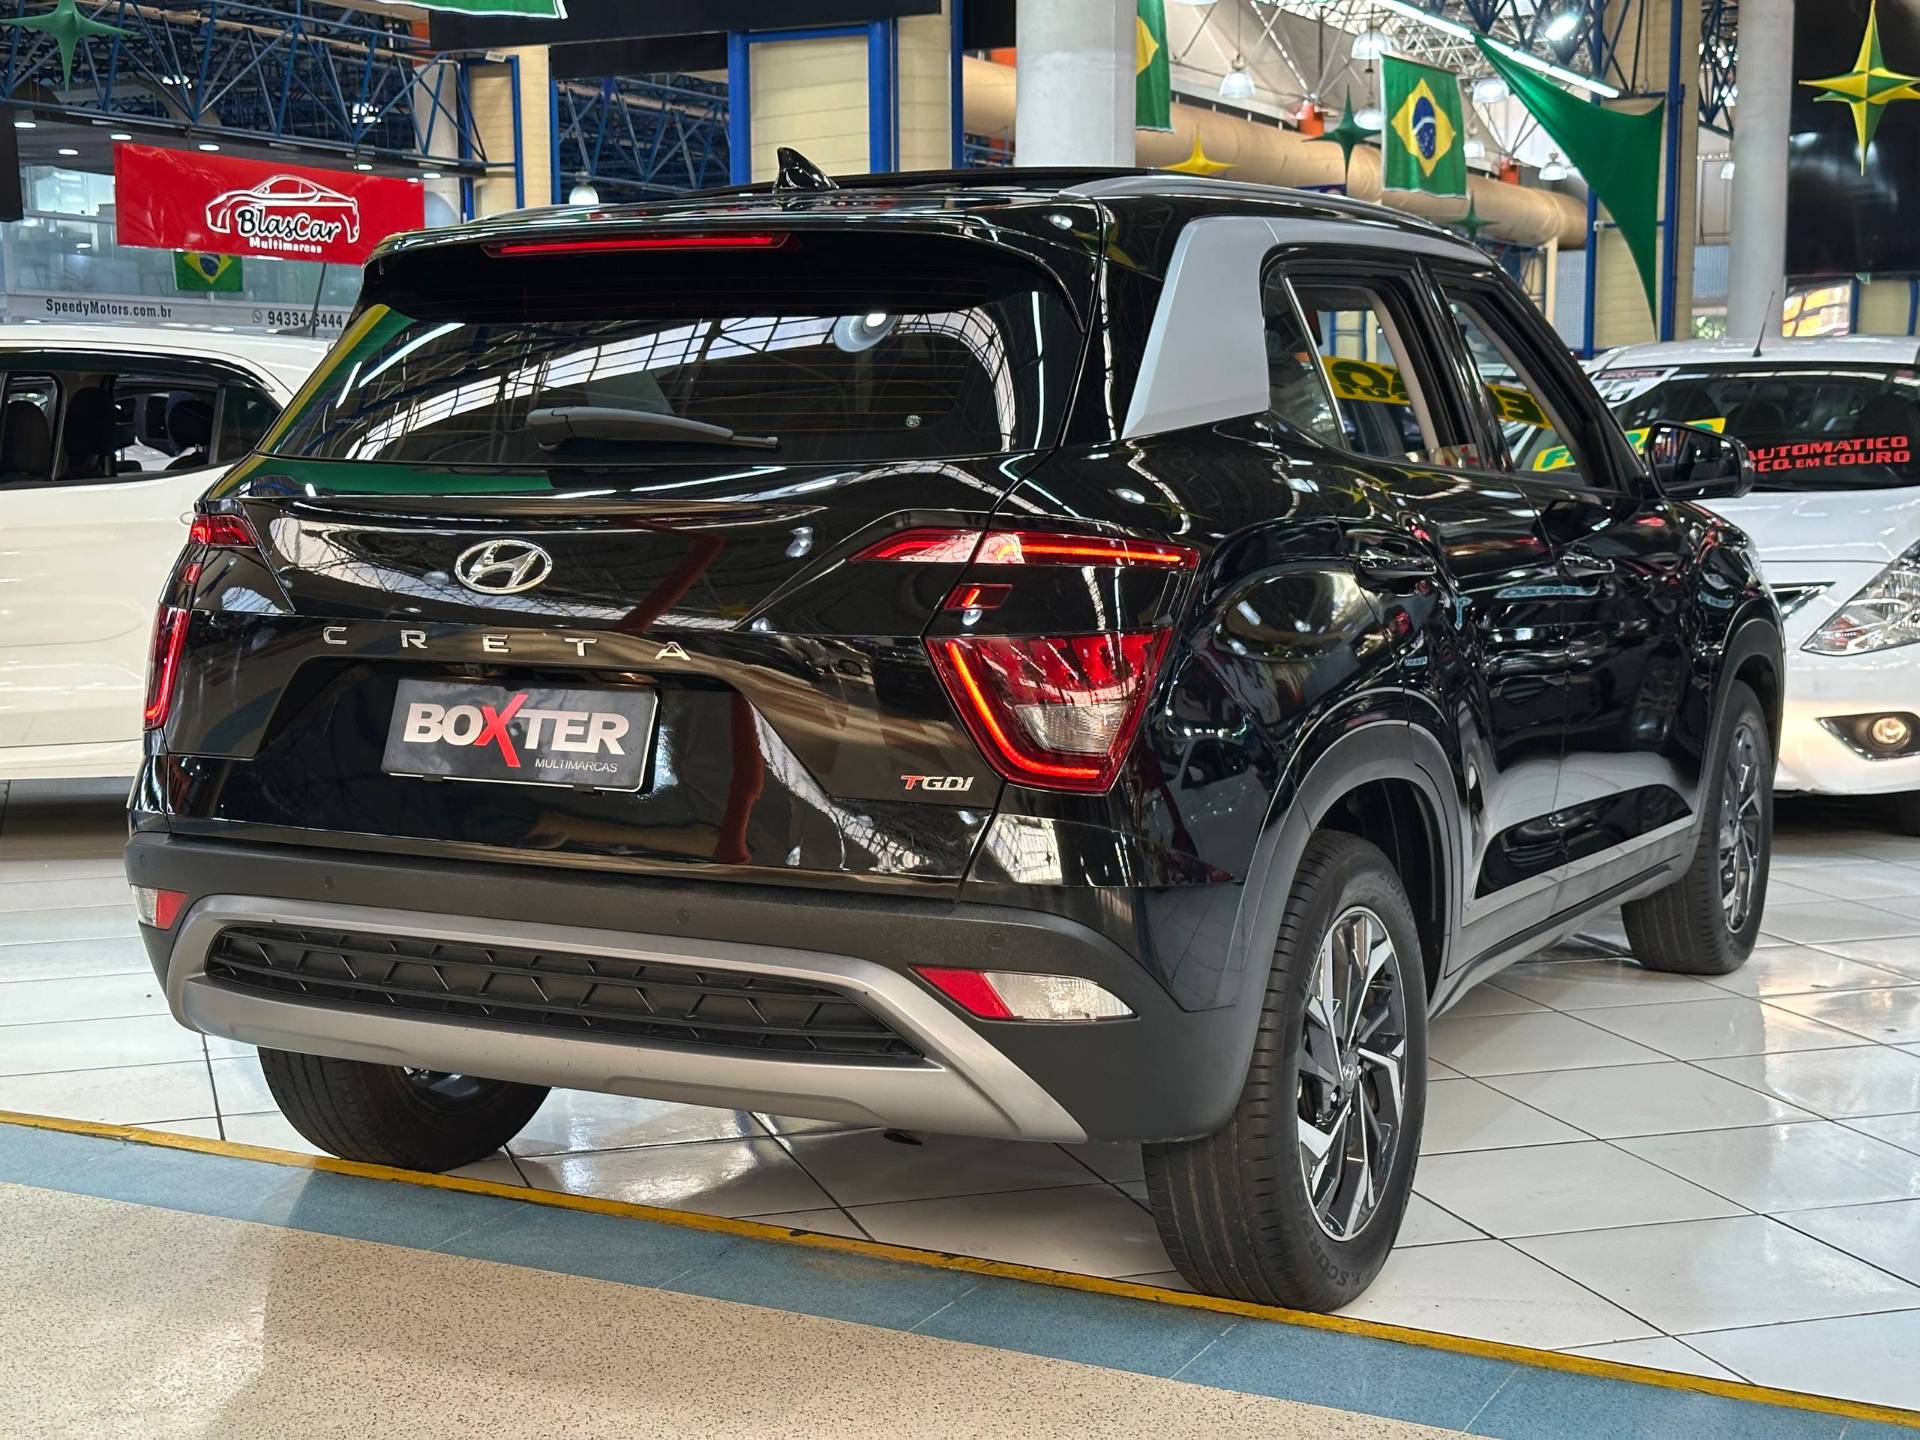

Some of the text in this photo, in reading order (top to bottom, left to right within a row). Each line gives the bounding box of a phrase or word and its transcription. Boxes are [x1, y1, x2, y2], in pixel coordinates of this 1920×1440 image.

[236, 205, 341, 243] BlasCar
[46, 298, 172, 317] SpeedyMotors.com.br
[1795, 457, 1820, 469] EM
[1824, 450, 1910, 466] COURO
[323, 626, 692, 661] CRETA
[403, 693, 629, 768] BOXTER
[534, 757, 618, 773] MULTIMARCAS
[900, 774, 974, 791] TGDI
